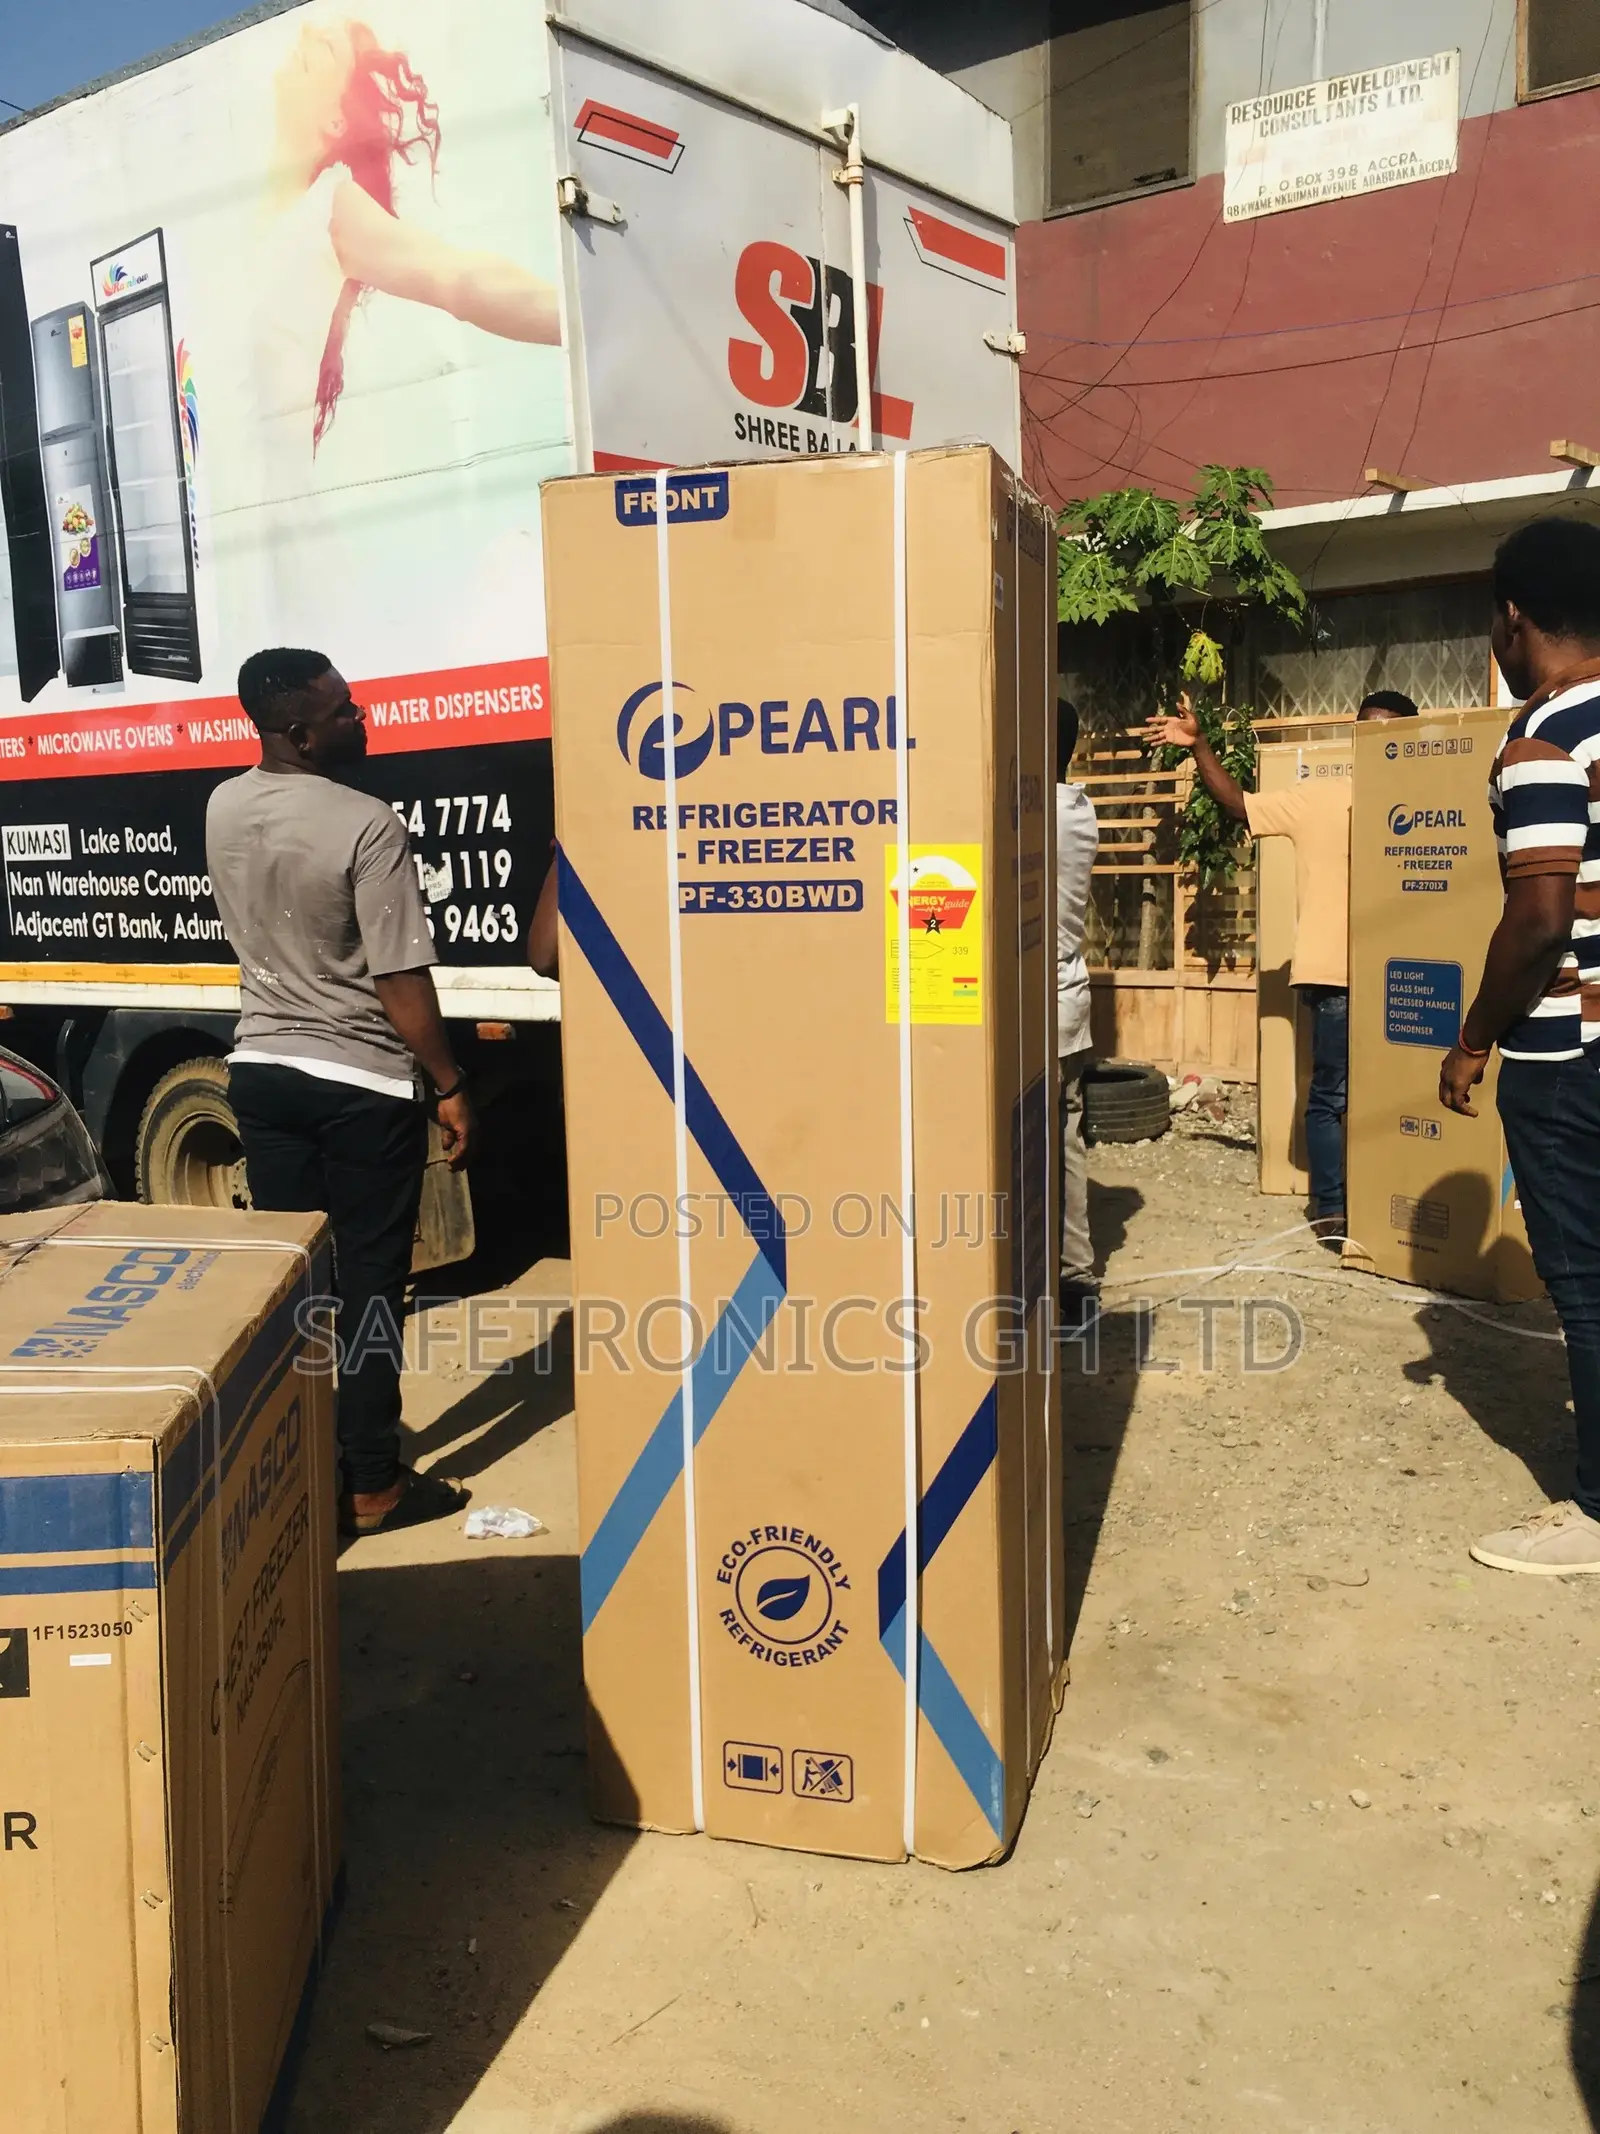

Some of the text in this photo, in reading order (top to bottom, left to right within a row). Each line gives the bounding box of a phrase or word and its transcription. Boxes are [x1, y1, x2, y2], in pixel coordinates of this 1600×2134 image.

[1231, 56, 1452, 125] RESOURCE DEVELOPMENT
[1260, 94, 1379, 138] CONSULTANTS
[1241, 193, 1272, 215] KWAME
[1274, 183, 1320, 207] NKRUMAH
[1322, 180, 1357, 196] AVENUE
[1362, 167, 1416, 188] ADABRAKA
[1419, 158, 1451, 176] ACCRA
[1326, 166, 1358, 181] 398
[728, 240, 914, 441] SBL
[734, 412, 801, 453] SHREE
[623, 486, 720, 515] FRONT
[0, 736, 26, 759] TERS
[37, 731, 122, 755] MICROWAVE
[125, 723, 174, 749] OVENS
[370, 697, 430, 728] WATER
[435, 683, 544, 720] DISPENSERS
[718, 695, 916, 756] PEARL
[435, 794, 512, 836] 7774
[632, 799, 898, 831] REFRIGERATOR
[1414, 809, 1467, 828] PEARL
[6, 824, 177, 856] KUMASI Lake Road,
[697, 837, 856, 865] FREEZER
[1384, 845, 1468, 857] REFRIGERATOR
[1403, 859, 1453, 871] FREEZER
[9, 871, 44, 897] Nan
[46, 869, 140, 897] Warehouse
[679, 885, 857, 909] PF-330BWD
[944, 899, 970, 911] guide
[15, 911, 88, 943] Adjacent
[92, 912, 115, 938] GT
[118, 912, 168, 943] Bank,
[444, 902, 520, 943] 9463
[930, 919, 937, 928] 2
[952, 946, 969, 956] 339
[1389, 970, 1424, 981] LED LIGHT
[1389, 983, 1435, 995] GLASS SHELF
[1389, 997, 1456, 1011] RECESSED HANDLE
[1389, 1010, 1418, 1021] OUTSIDE
[1389, 1023, 1433, 1035] CONDENSER
[34, 1248, 191, 1337] NASCO
[232, 1395, 301, 1566] NASCO
[252, 1491, 310, 1632] FREEZER
[716, 1525, 852, 1591] ECO-FRIENDLY
[33, 1621, 134, 1641] 1F1523050
[719, 1608, 850, 1668] REFRIGERANT
[3, 1811, 39, 1851] R
